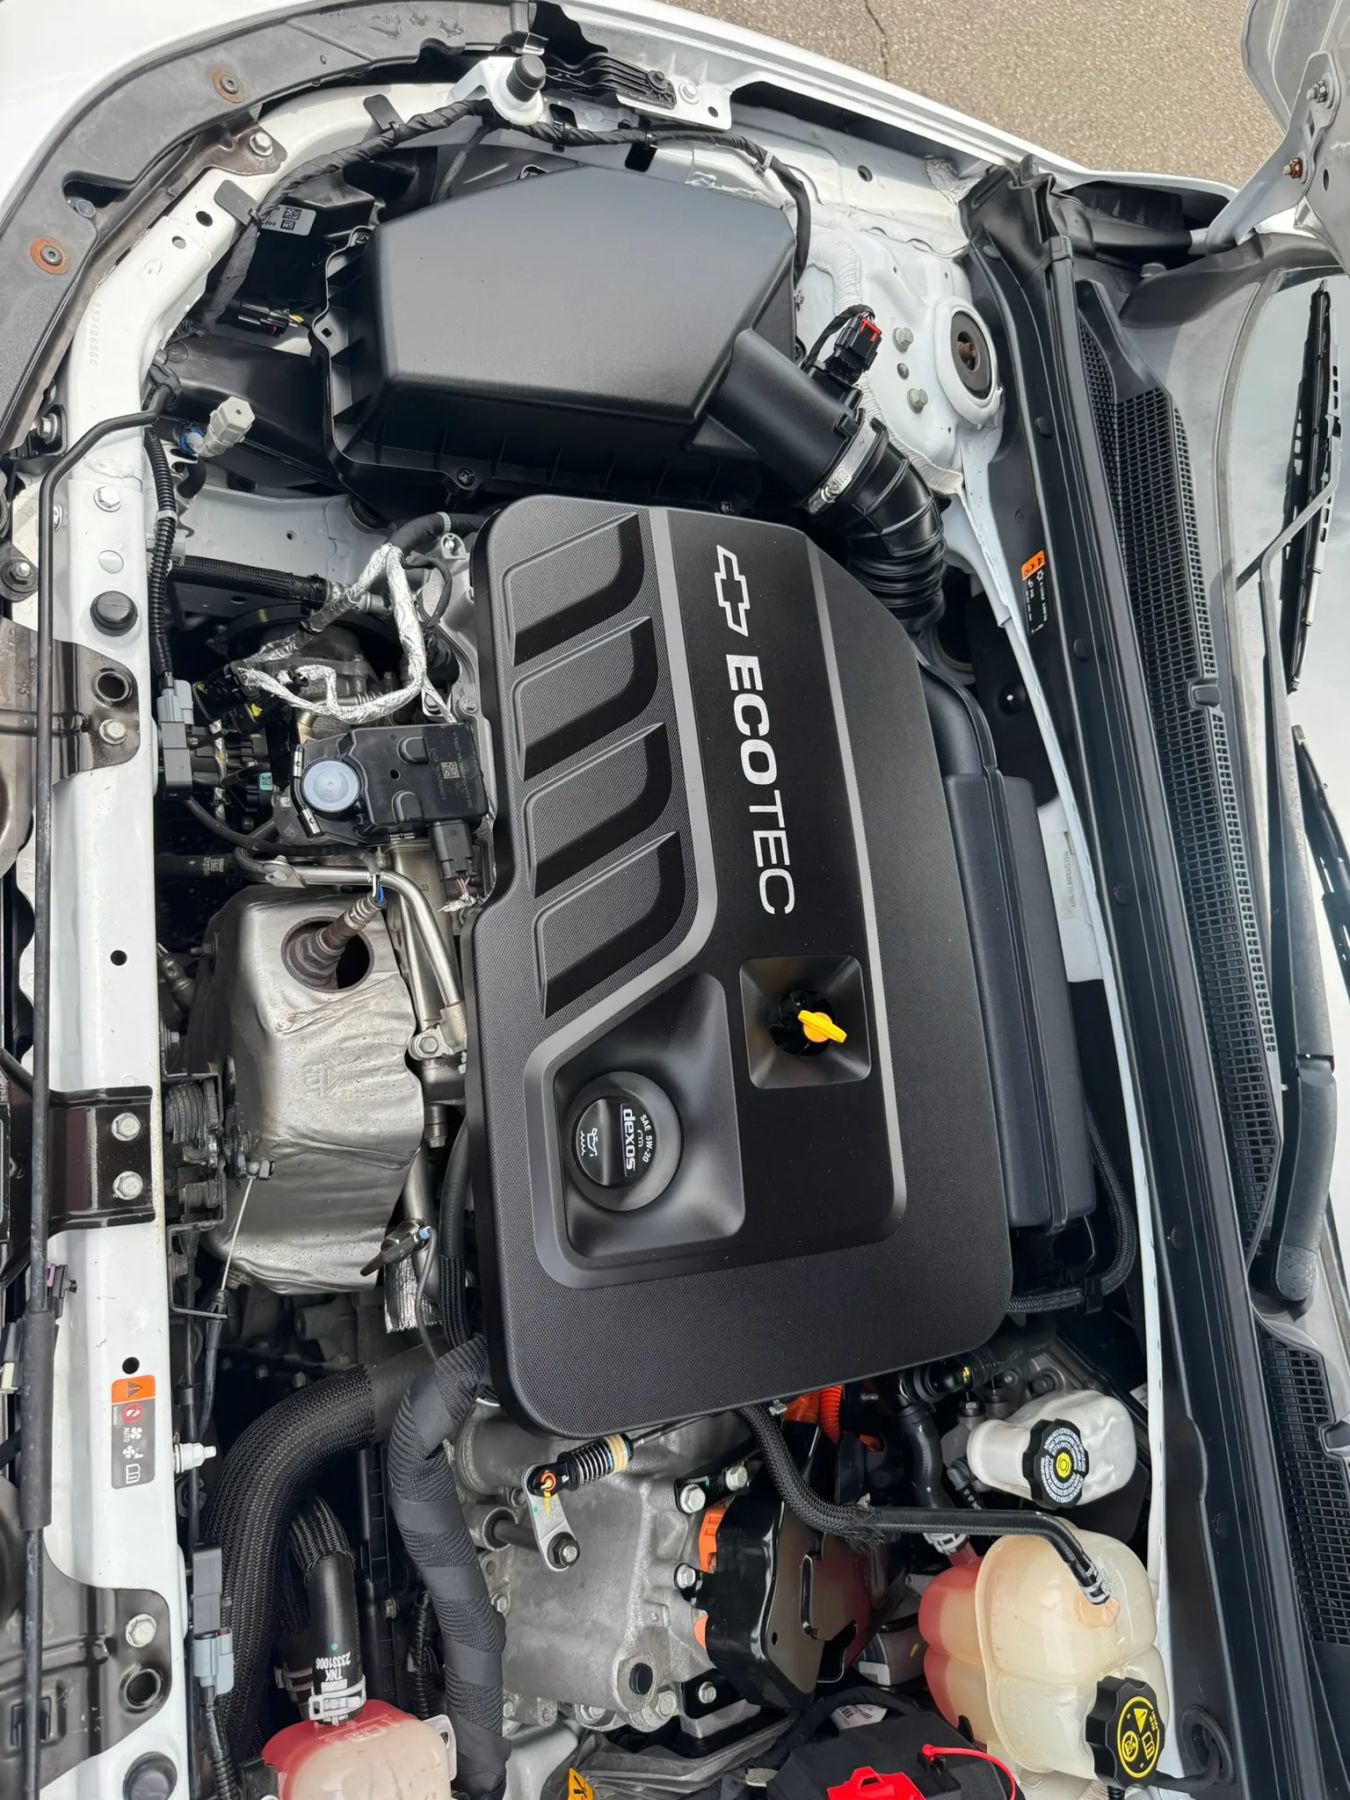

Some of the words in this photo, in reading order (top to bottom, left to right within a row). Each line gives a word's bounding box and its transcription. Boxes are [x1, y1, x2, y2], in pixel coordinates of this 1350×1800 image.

[726, 654, 796, 915] ECOTEC
[640, 1114, 651, 1131] SAE
[623, 1109, 636, 1172] dexos
[642, 1135, 652, 1163] 5W-20
[123, 1427, 131, 1443] AUTO
[325, 1667, 343, 1682] TNK
